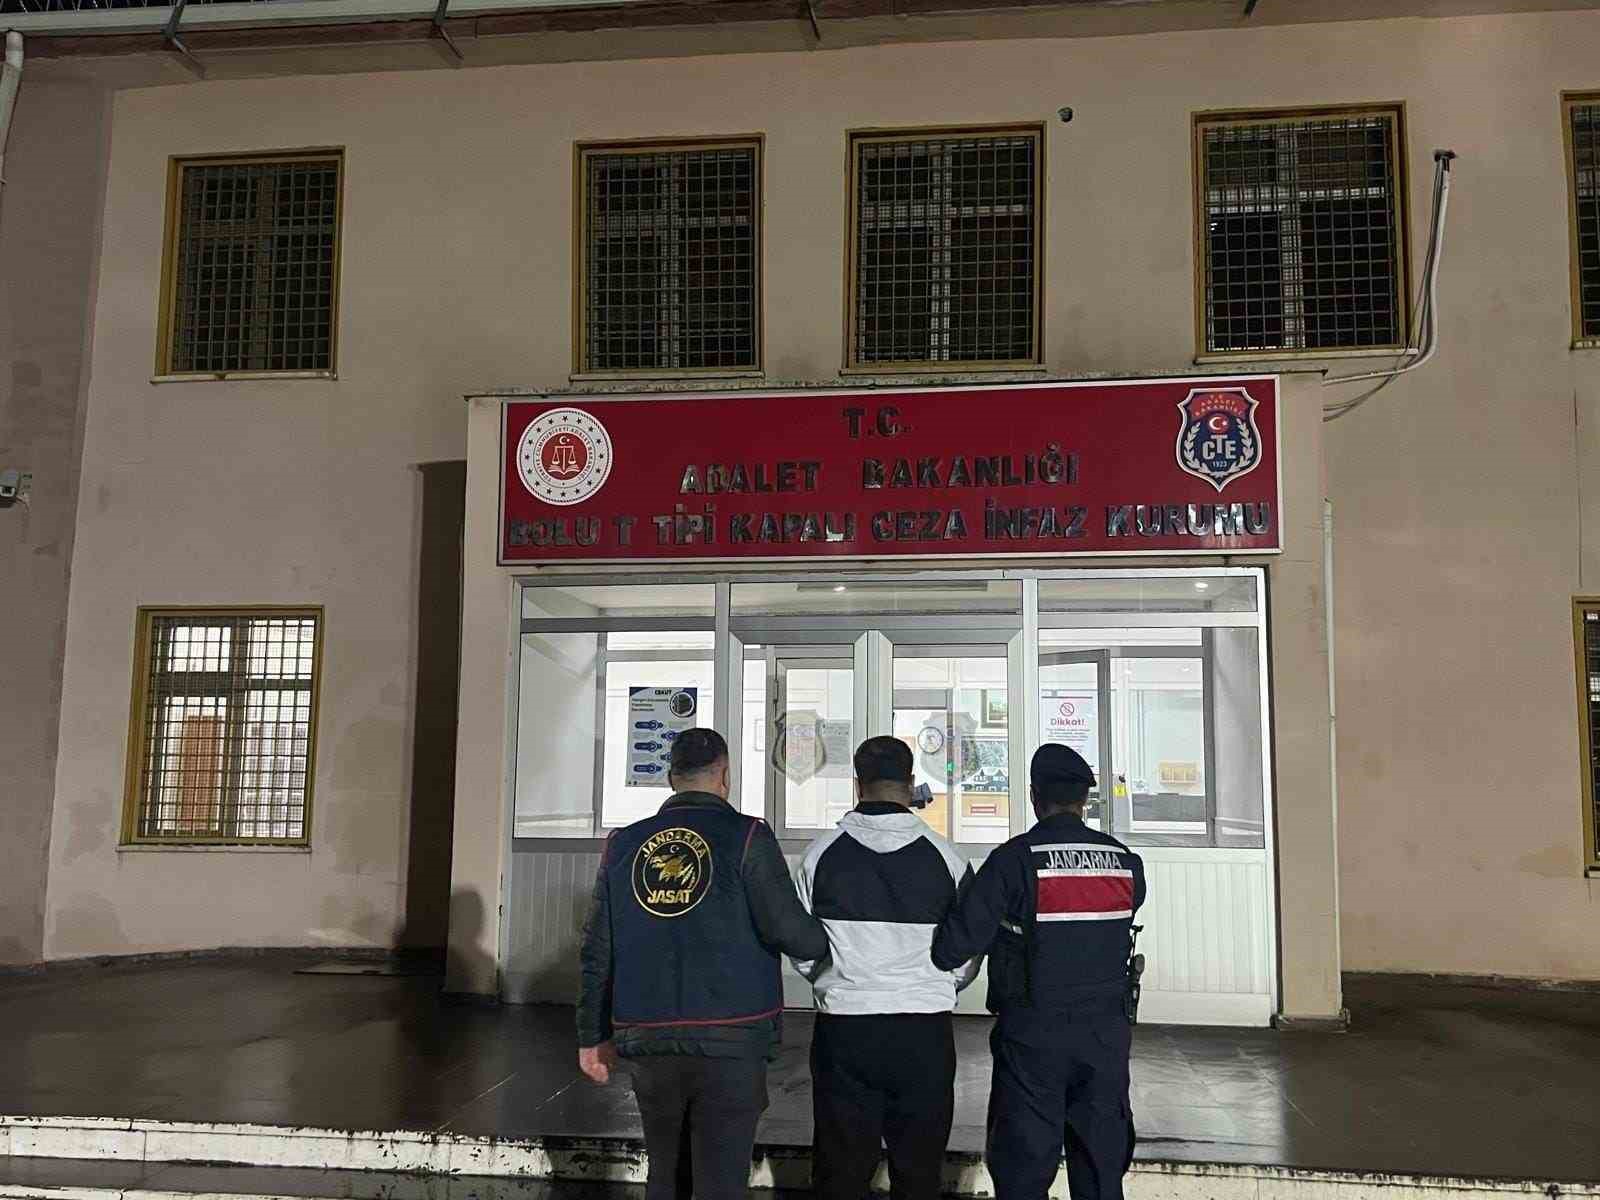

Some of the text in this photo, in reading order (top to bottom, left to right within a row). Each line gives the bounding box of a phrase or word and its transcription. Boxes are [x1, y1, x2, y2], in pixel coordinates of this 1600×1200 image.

[843, 406, 912, 439] T.C.
[1202, 434, 1236, 460] CTE
[680, 443, 1079, 494] ADALET BAKANLIĞI
[509, 499, 1269, 546] BOLU T TİPİ KAPALI CEZA İNFAZ KURUMU
[1050, 718, 1085, 727] Dikkat!
[642, 831, 707, 858] JANDARMA
[1046, 850, 1122, 870] JANDARMA
[647, 889, 693, 905] JASAT
